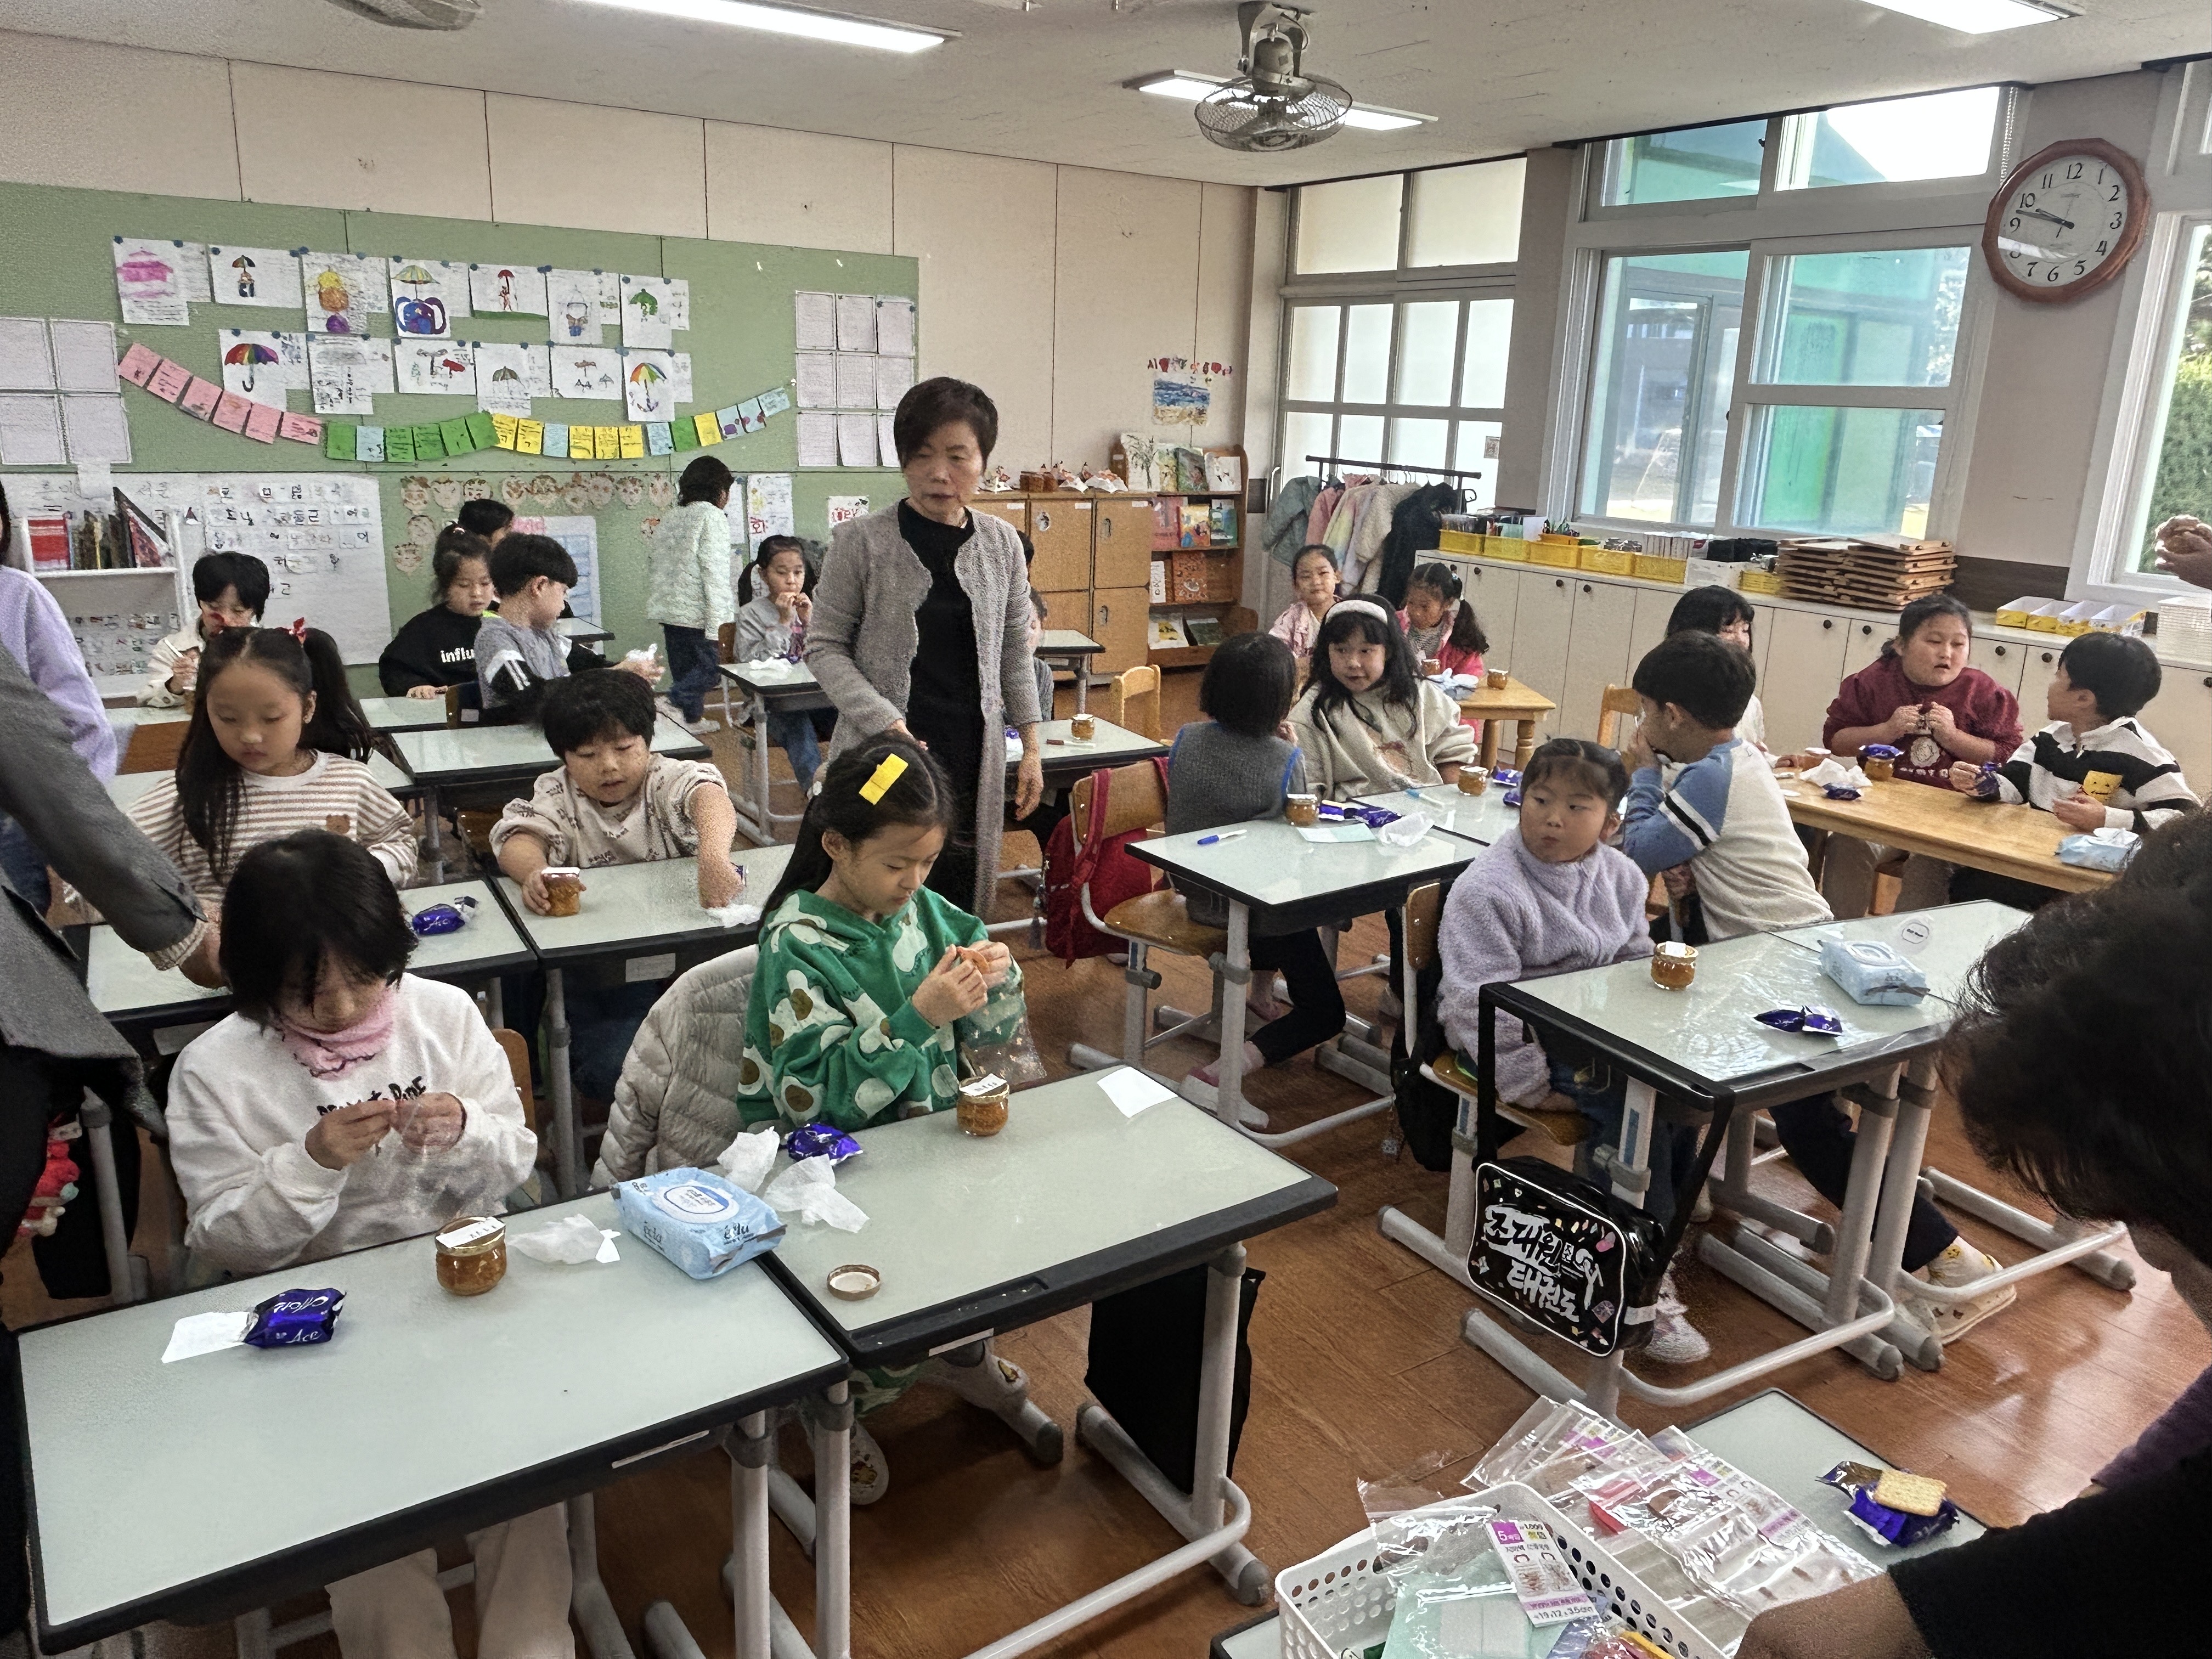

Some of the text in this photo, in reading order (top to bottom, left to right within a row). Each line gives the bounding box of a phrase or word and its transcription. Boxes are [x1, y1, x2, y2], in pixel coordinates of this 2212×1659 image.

[2067, 162, 2084, 179] 12
[2098, 166, 2106, 185] 1
[2041, 173, 2053, 189] 11
[2019, 193, 2035, 208] 10
[2108, 185, 2119, 201] 2
[2010, 217, 2021, 233] 9
[2110, 212, 2122, 229] 3
[2095, 240, 2107, 256] 4
[2027, 262, 2039, 276] 7
[2047, 266, 2059, 281] 6
[2074, 259, 2086, 275] 5
[1507, 1260, 1580, 1323] 태권도
[286, 1329, 321, 1344] Ace
